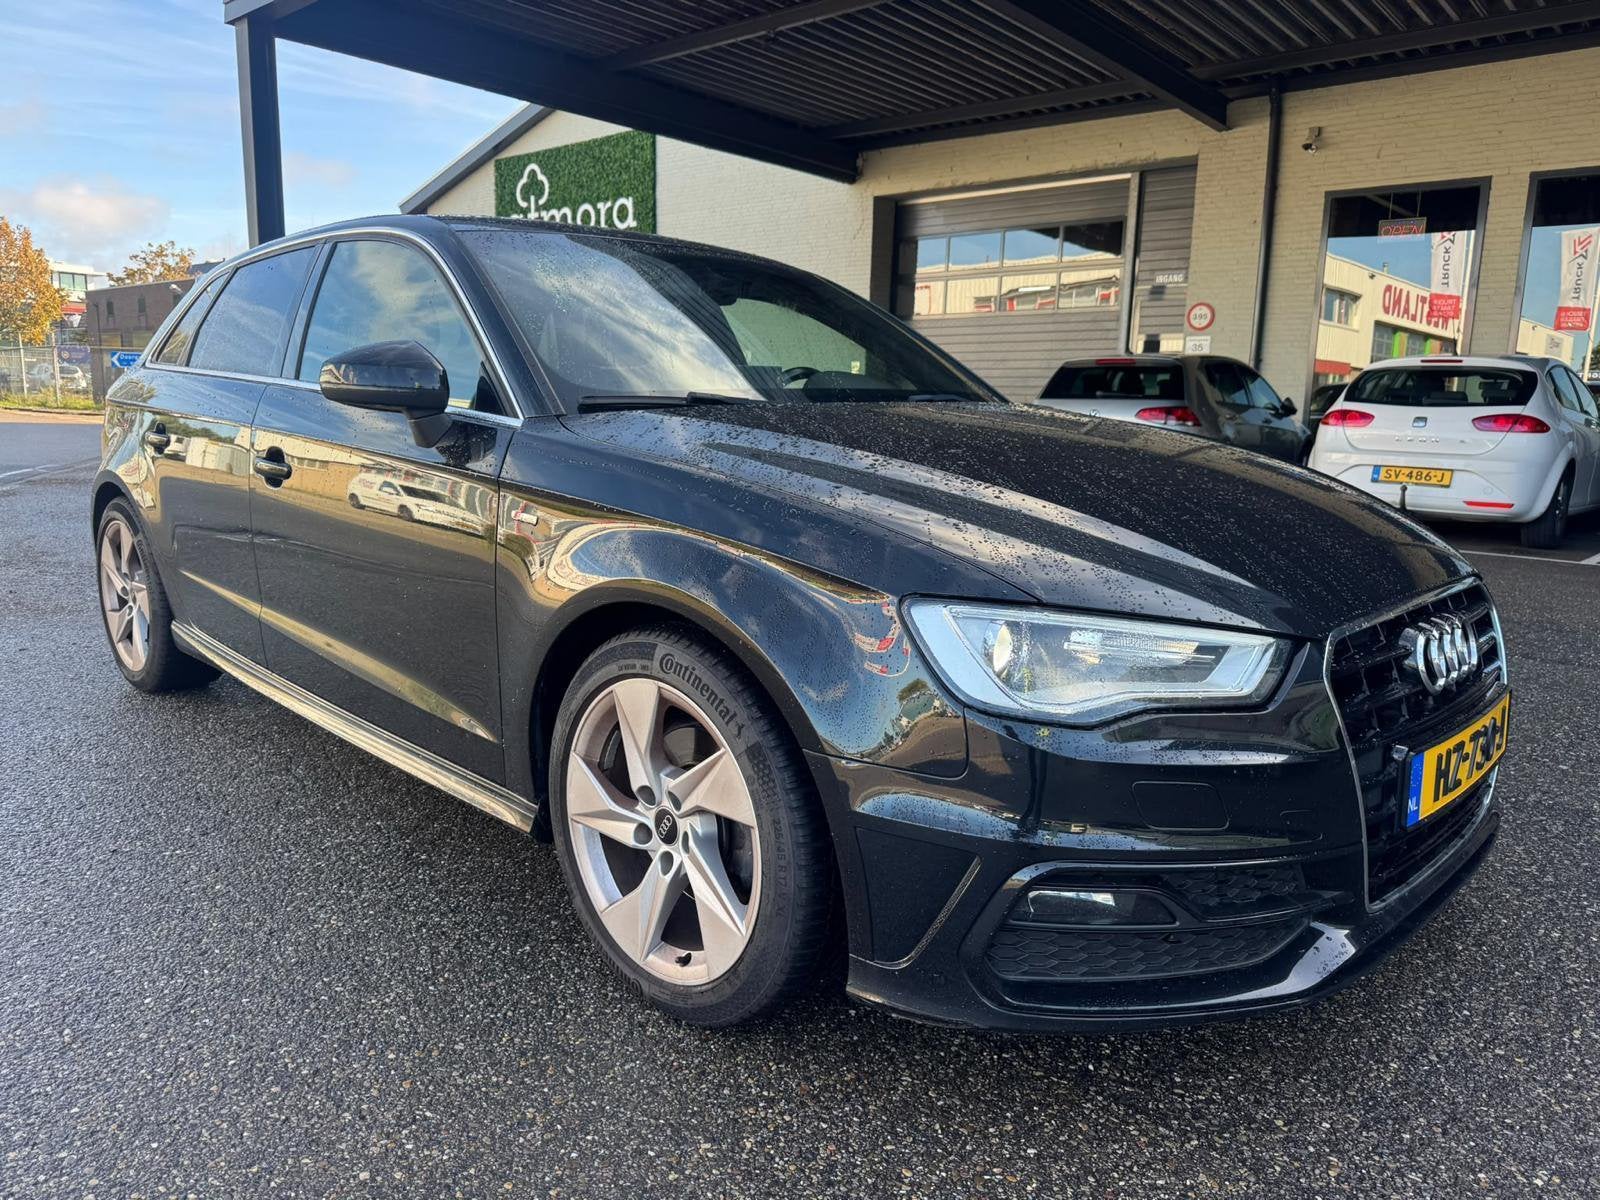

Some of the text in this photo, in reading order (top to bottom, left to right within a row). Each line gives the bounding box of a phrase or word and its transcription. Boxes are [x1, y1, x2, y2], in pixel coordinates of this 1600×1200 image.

[510, 195, 637, 230] tmora
[1381, 223, 1424, 237] OPEN
[1384, 469, 1445, 483] SV-486-J
[659, 653, 738, 727] Continental
[1407, 797, 1418, 813] NL
